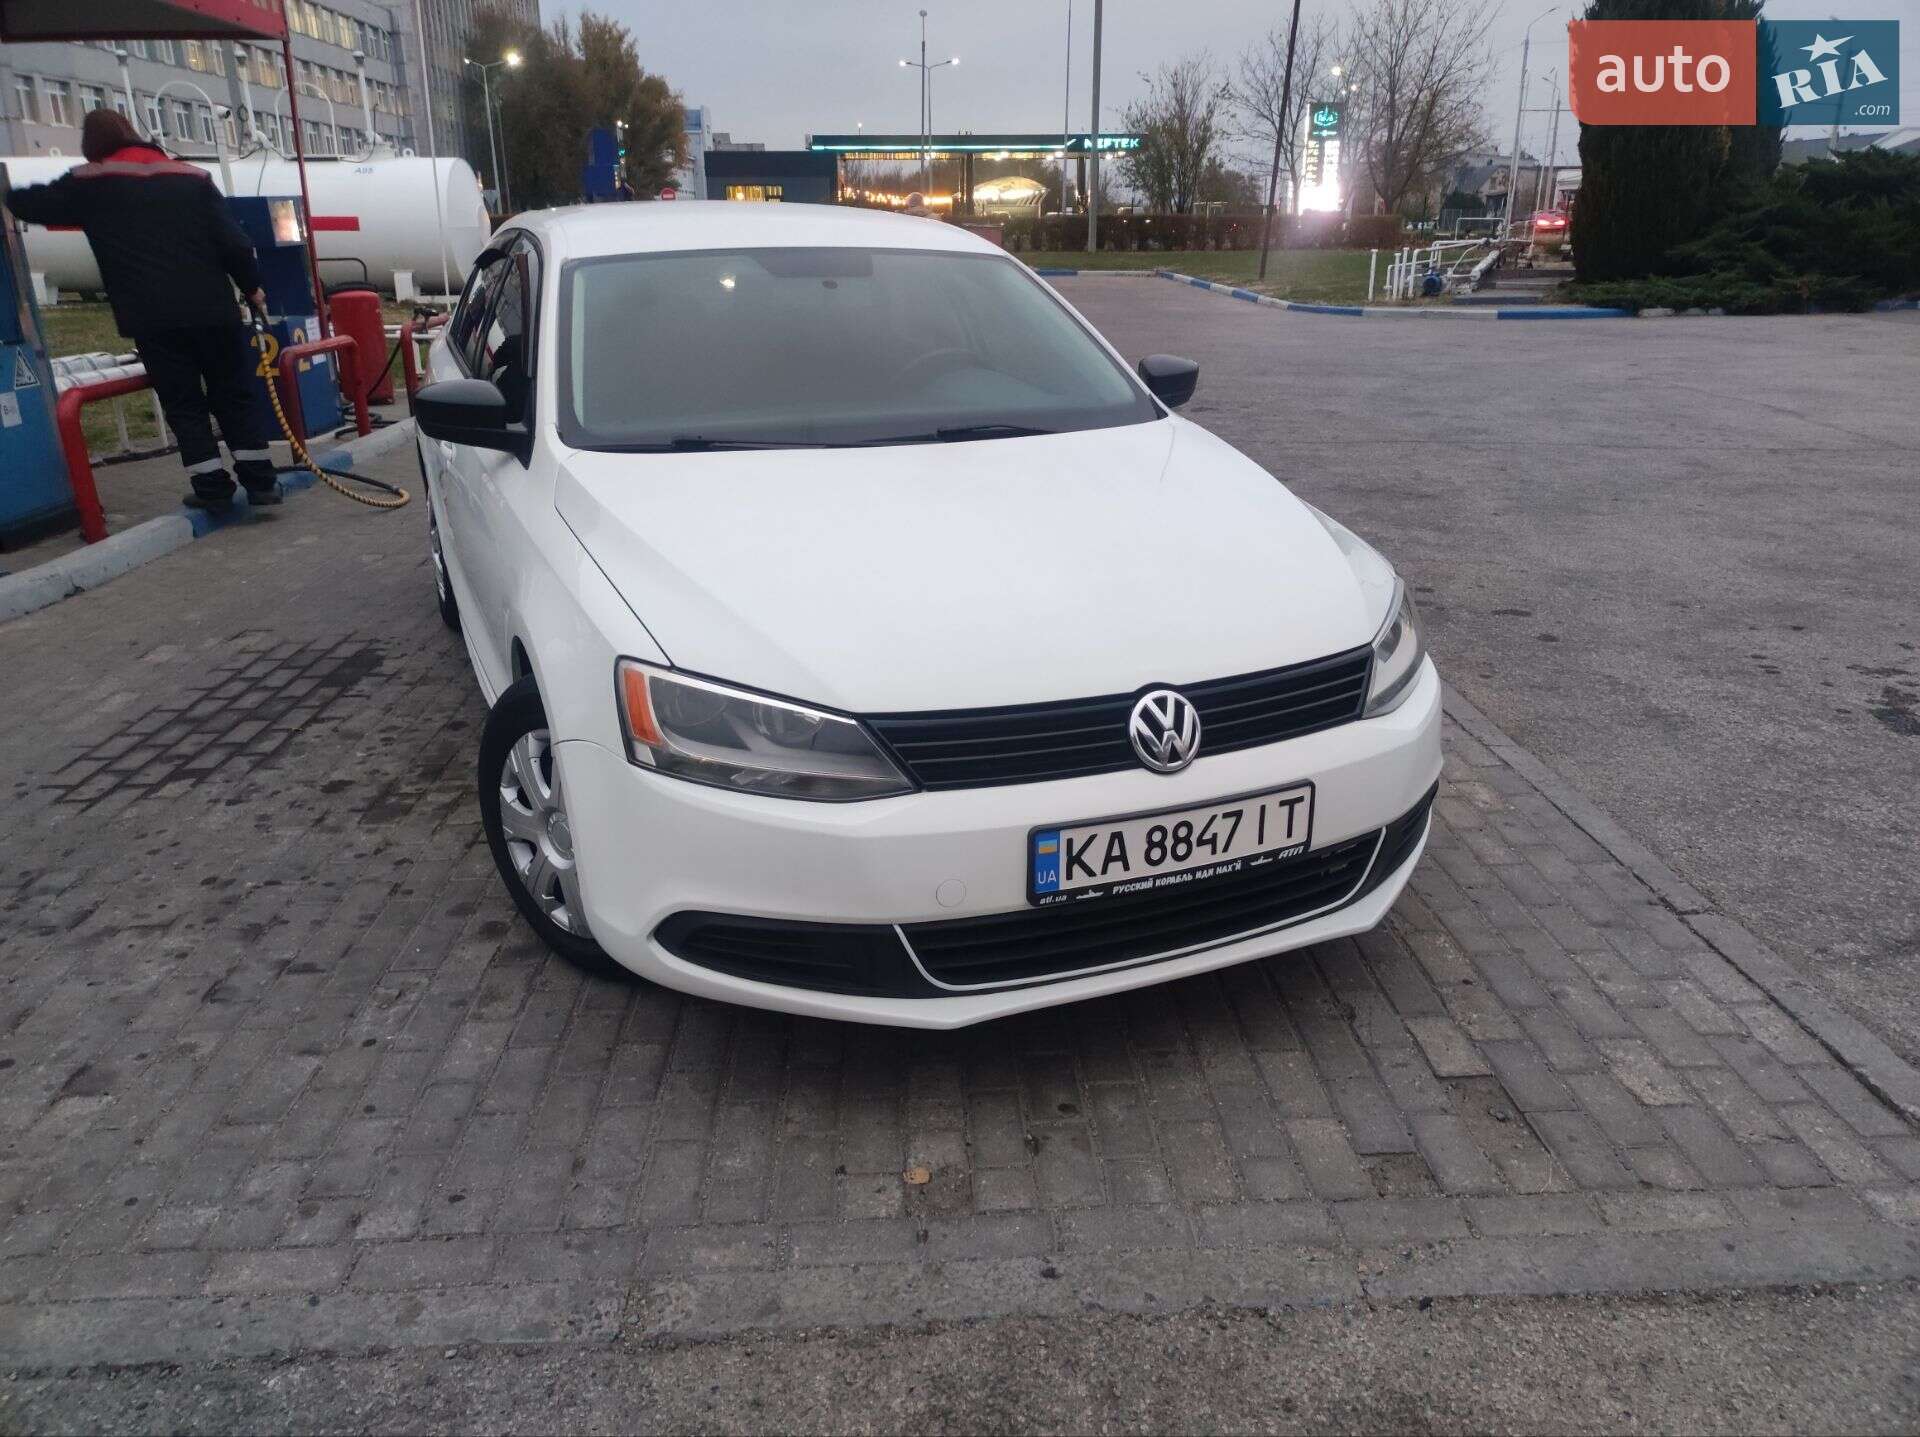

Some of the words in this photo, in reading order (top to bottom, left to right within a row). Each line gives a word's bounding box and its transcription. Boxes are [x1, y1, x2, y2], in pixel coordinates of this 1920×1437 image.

[1144, 809, 1244, 866] 8847
[1038, 869, 1057, 884] UA
[1112, 877, 1154, 895] РУССКИЙ
[1155, 871, 1193, 887] КОРАБЛЬ
